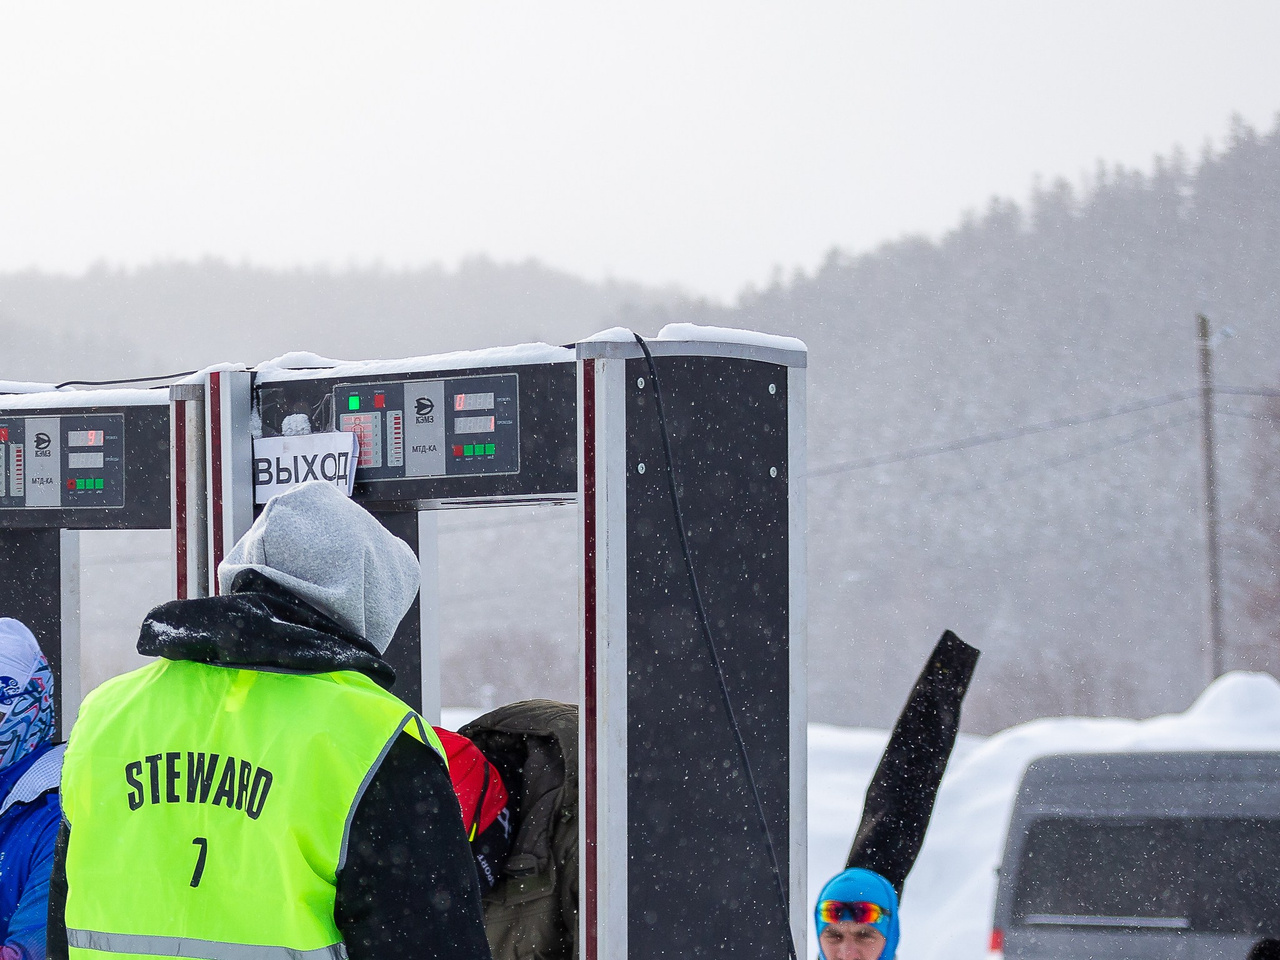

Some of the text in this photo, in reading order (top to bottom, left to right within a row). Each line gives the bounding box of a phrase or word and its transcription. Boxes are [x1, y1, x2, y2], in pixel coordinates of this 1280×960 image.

[254, 452, 349, 486] ВЫХОД
[124, 751, 274, 821] STEWARD
[189, 837, 208, 888] 7
